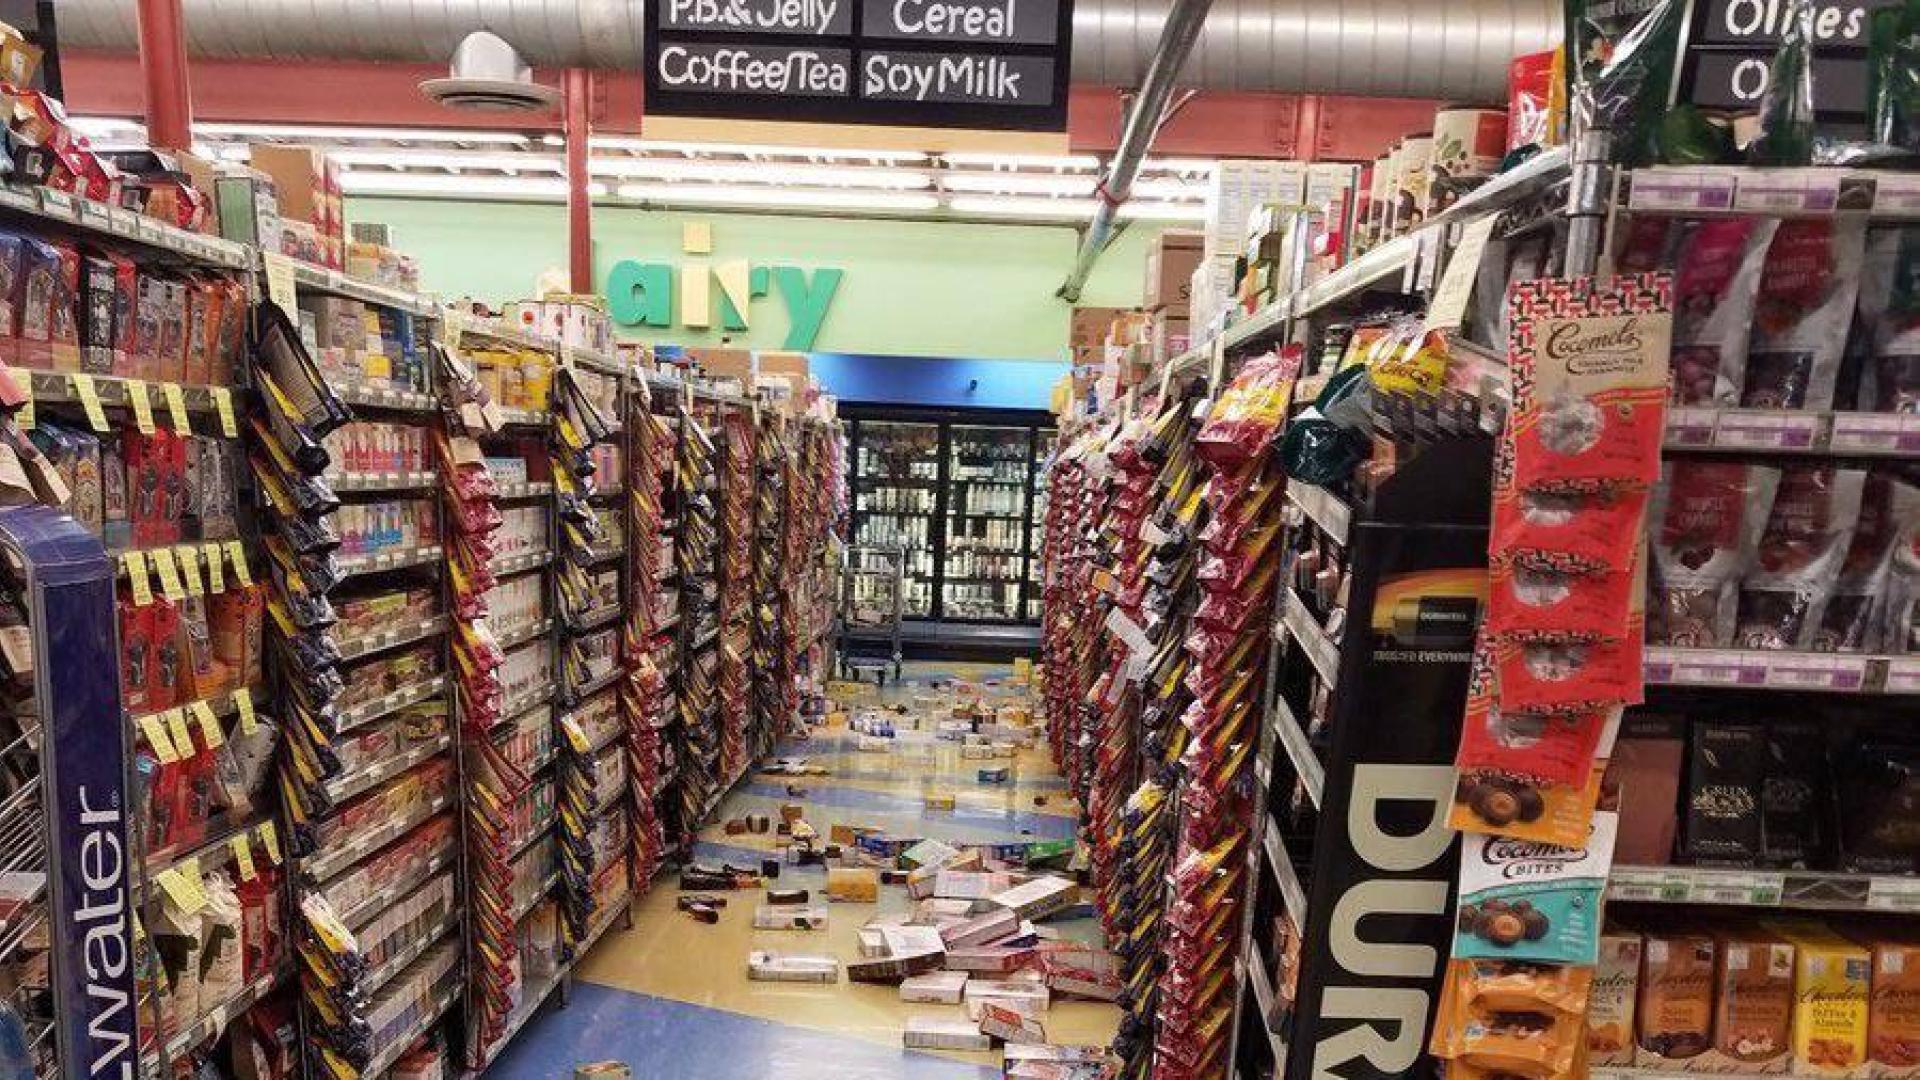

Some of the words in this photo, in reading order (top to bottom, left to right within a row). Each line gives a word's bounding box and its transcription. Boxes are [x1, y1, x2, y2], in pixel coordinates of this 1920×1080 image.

[893, 0, 1017, 37] Cereal
[865, 55, 934, 101] Soy
[938, 57, 1022, 99] Milk
[538, 221, 843, 352] airy
[73, 785, 133, 1080] water
